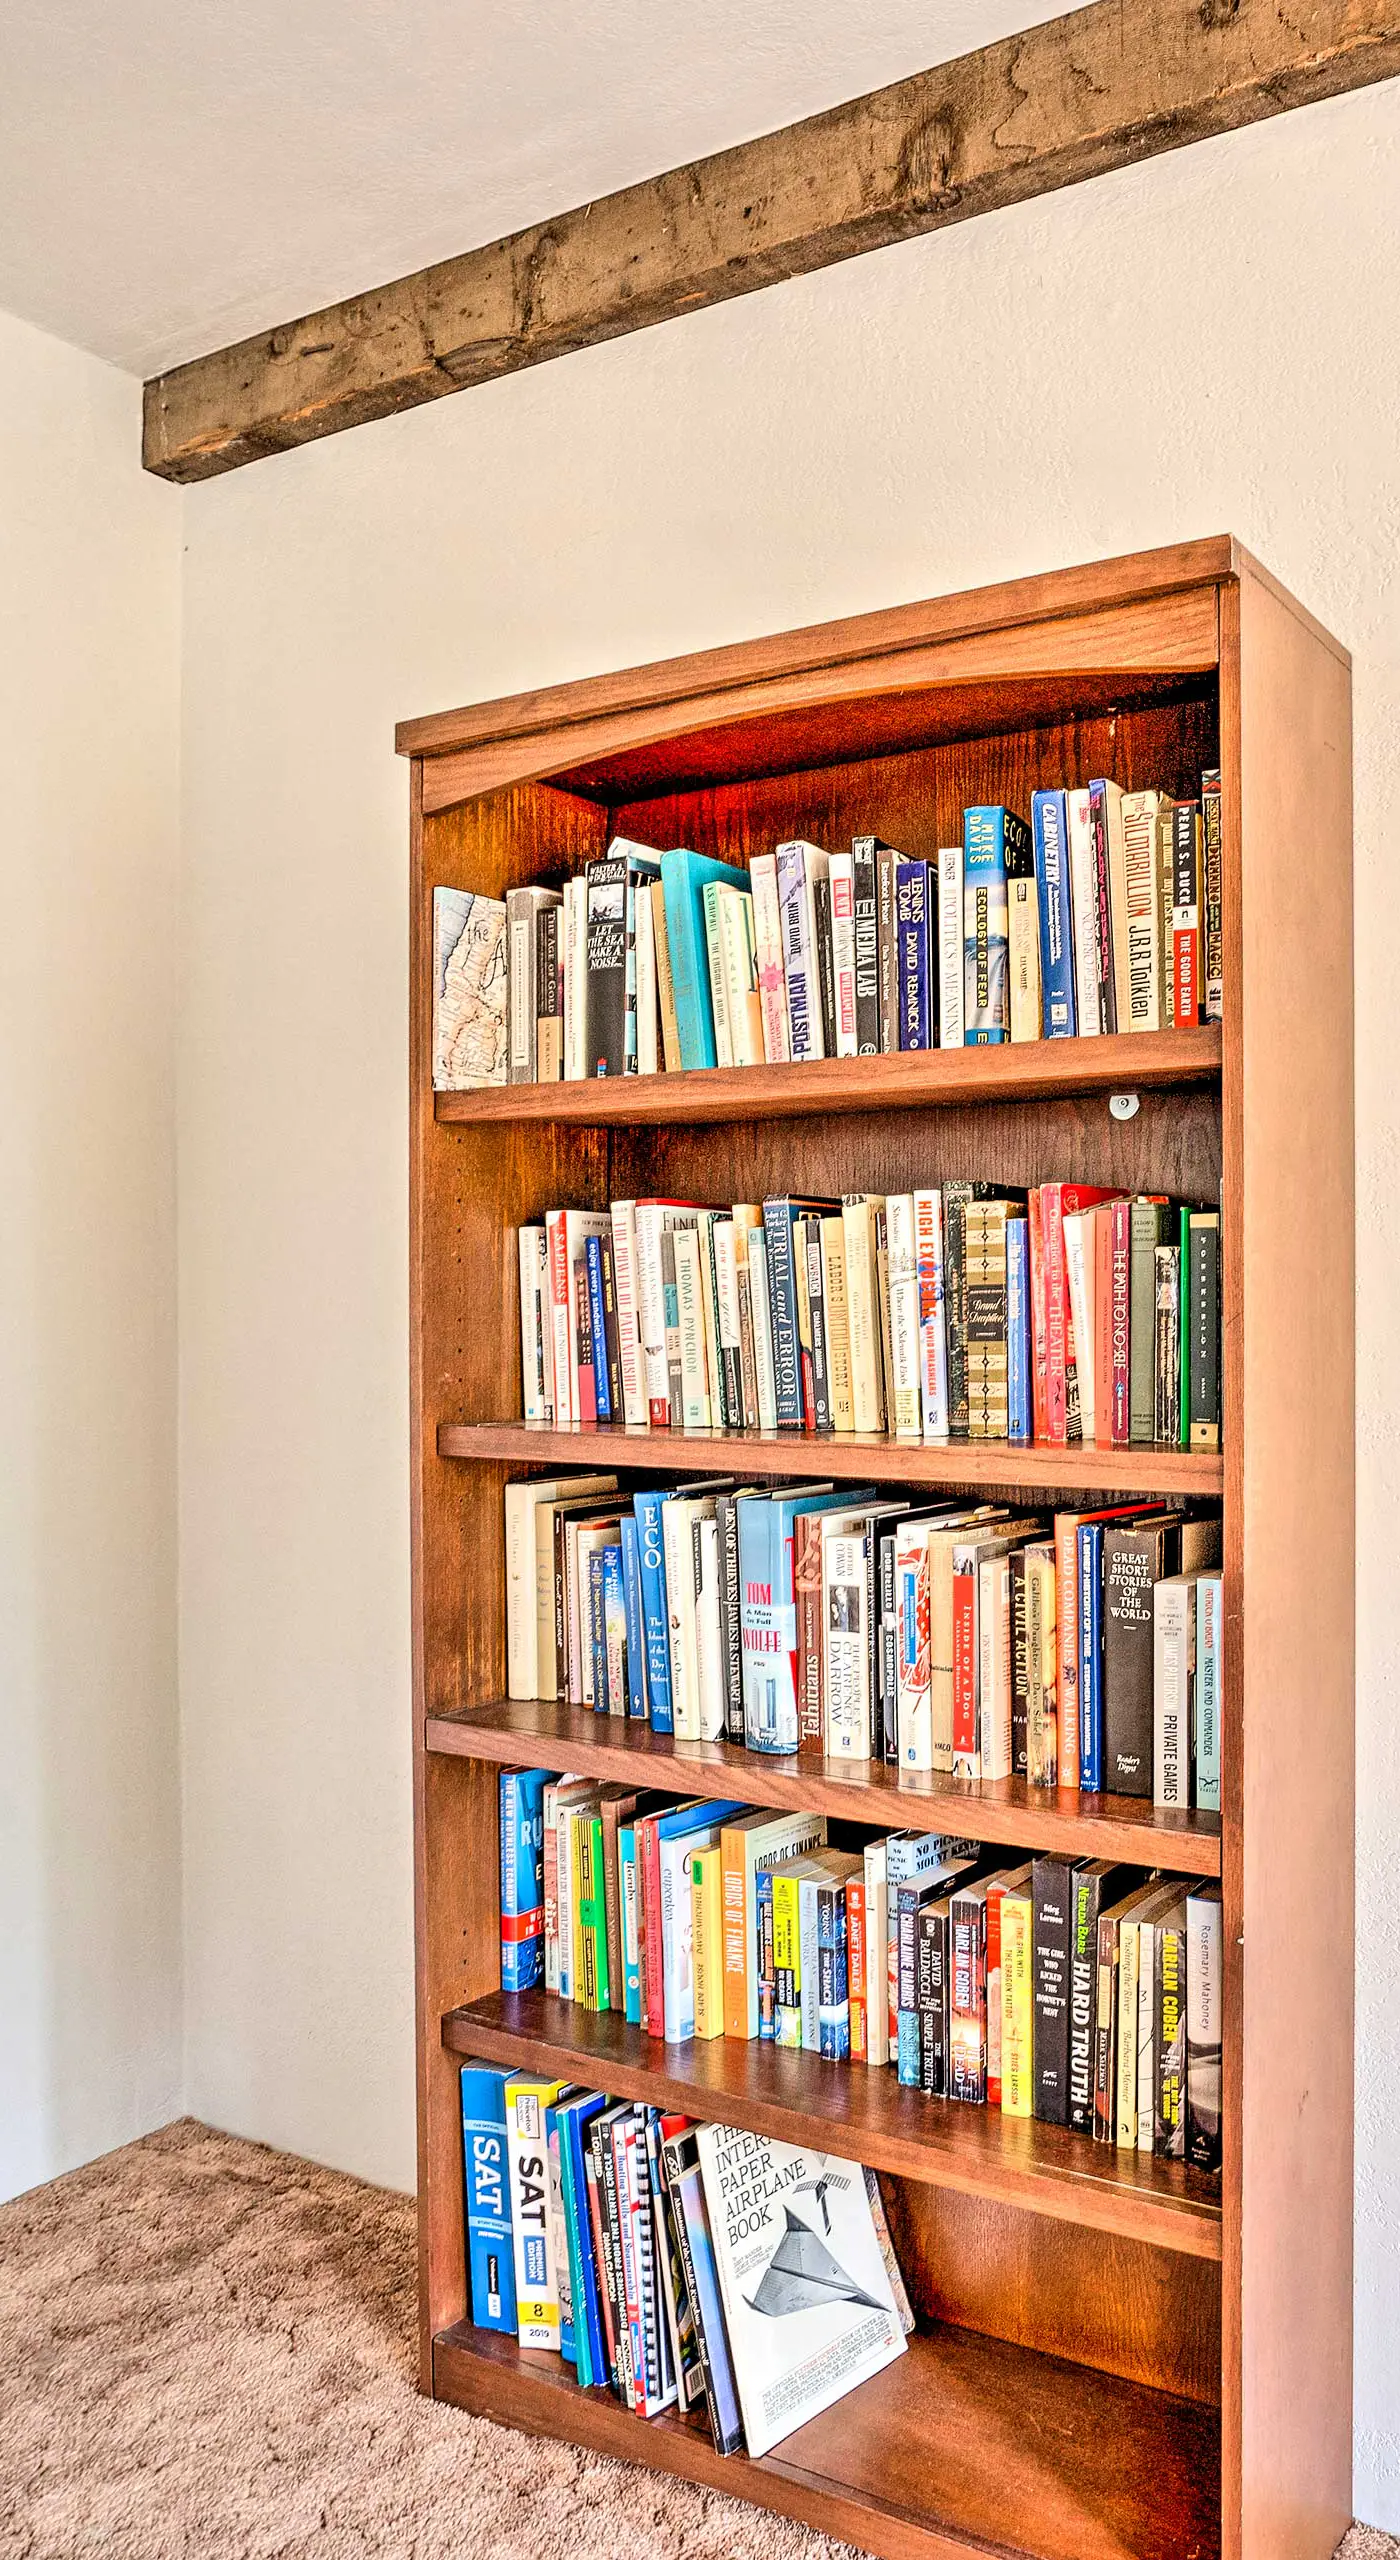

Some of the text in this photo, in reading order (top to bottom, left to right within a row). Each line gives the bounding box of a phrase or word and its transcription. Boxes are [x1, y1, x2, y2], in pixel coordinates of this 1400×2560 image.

[969, 815, 981, 864] DAVIS
[981, 823, 994, 863] MIKE
[1042, 804, 1060, 884] CABINETRY
[1125, 795, 1152, 918] The SILMARILLION
[1178, 808, 1190, 903] PEARL S. BUCK
[547, 912, 556, 935] THE
[900, 884, 910, 921] TOMB
[549, 964, 555, 976] OF
[857, 920, 876, 997] MEDIA LAB
[976, 888, 988, 1007] ECOLOGY OF FEAR
[548, 980, 557, 1013] GOLD
[907, 931, 919, 1031] DAVID REMNICK
[1180, 935, 1190, 1016] THE GOOD EARTH
[788, 973, 811, 1055] POSTMAN
[677, 1235, 690, 1244] V.
[918, 1200, 936, 1317] HIGH EXPOSURE
[1049, 1208, 1060, 1266] Orientation
[1114, 1249, 1126, 1271] THE
[554, 1234, 565, 1299] SAPIENS
[1051, 1270, 1060, 1281] to
[1114, 1273, 1126, 1302] PATH
[588, 1243, 601, 1339] enjoy every sandwich
[614, 1222, 638, 1394] THE POWER OF PARTNERSHIP
[773, 1228, 797, 1395] TRIAL and ERROR
[895, 1289, 905, 1313] Where
[1114, 1305, 1126, 1318] TO
[680, 1259, 696, 1374] THOMAS PYNCHON
[1051, 1305, 1062, 1376] THEATER
[898, 1330, 908, 1362] Sidewalk
[899, 1364, 908, 1384] Ends
[725, 1507, 738, 1601] DEN OF THIEVES
[1111, 1564, 1149, 1577] SHORT
[1112, 1552, 1148, 1565] GREAT
[1031, 1578, 1040, 1618] Galileo's
[1109, 1574, 1152, 1589] STORIES
[1119, 1596, 1141, 1609] THE
[1122, 1586, 1137, 1597] OF
[1205, 1589, 1213, 1617] PATRICK
[1015, 1577, 1026, 1695] A CIVIL ACTION
[1110, 1607, 1151, 1621] WORLD
[727, 1604, 744, 1703] JAMES B. STEWART
[962, 1605, 972, 1720] INSIDE OF A DOG
[1031, 1623, 1041, 1668] Daughter
[1062, 1536, 1076, 1754] DEAD COMPANIES WALKING
[829, 1641, 842, 1724] DARROW
[842, 1641, 852, 1726] CLARENCE
[1204, 1657, 1213, 1686] MASTER
[800, 1656, 820, 1740] Tahitians
[1204, 1690, 1213, 1705] AND
[1033, 1710, 1042, 1736] Sobel
[1204, 1709, 1213, 1756] COMMANDER
[1164, 1715, 1177, 1801] PRIVATE GAMES
[545, 1898, 556, 1936] dirt
[725, 1871, 743, 1975] LORDS OF FINANCE
[821, 1903, 830, 1938] YOUNG
[900, 1913, 917, 2007] CHARLAINE HARRIS
[919, 1939, 931, 1994] BALDACCI
[931, 1952, 942, 1985] DAVID
[1200, 1925, 1212, 2030] Rosemary Mahoney
[822, 1968, 832, 2005] SHACK
[1071, 1887, 1090, 2104] NEVADA BARR HARD TRUTH
[1163, 1935, 1177, 2041] HARLAN COBEN
[924, 2013, 934, 2086] SIMPLE TRUTH
[1011, 2052, 1019, 2105] STIEG LARSSON
[473, 2136, 504, 2215] SAT
[592, 2136, 603, 2178] LOU REED
[720, 2152, 774, 2198] PAPER
[518, 2156, 545, 2231] SAT
[727, 2158, 806, 2222] AIRPLANE
[602, 2232, 612, 2259] DIANA
[603, 2153, 630, 2328] DISPATCHES FROM THE TENTH CIRCLE
[618, 2155, 636, 2301] Boating Skills and Seamanship
[728, 2203, 774, 2247] BOOK
[528, 2242, 537, 2278] EDITION
[535, 2240, 545, 2281] PREMIUM
[605, 2259, 616, 2302] CLAPTON
[529, 2329, 549, 2338] 2019
[533, 2304, 544, 2318] 8
